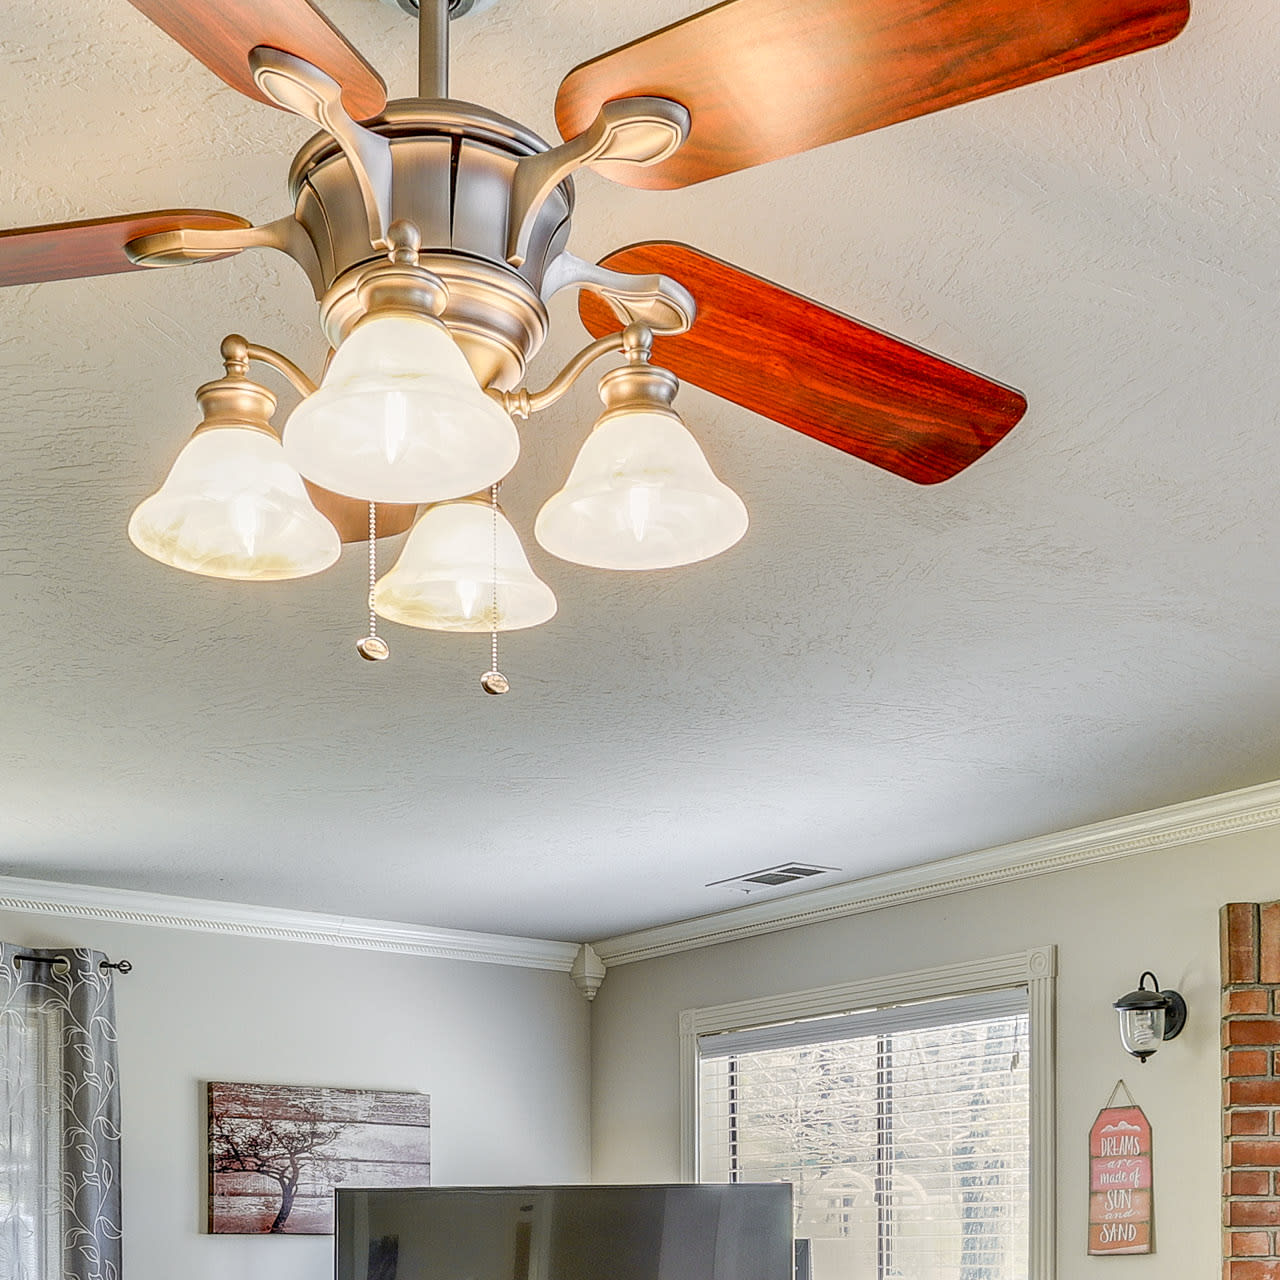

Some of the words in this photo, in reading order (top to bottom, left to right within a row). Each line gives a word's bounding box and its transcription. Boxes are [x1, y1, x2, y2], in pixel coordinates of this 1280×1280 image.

[1101, 1135, 1141, 1157] DREAMS
[1102, 1159, 1139, 1168] are
[1100, 1170, 1127, 1185] made
[1129, 1167, 1141, 1188] of
[1104, 1188, 1132, 1211] SUN
[1102, 1208, 1137, 1220] and
[1099, 1222, 1137, 1243] SAND
